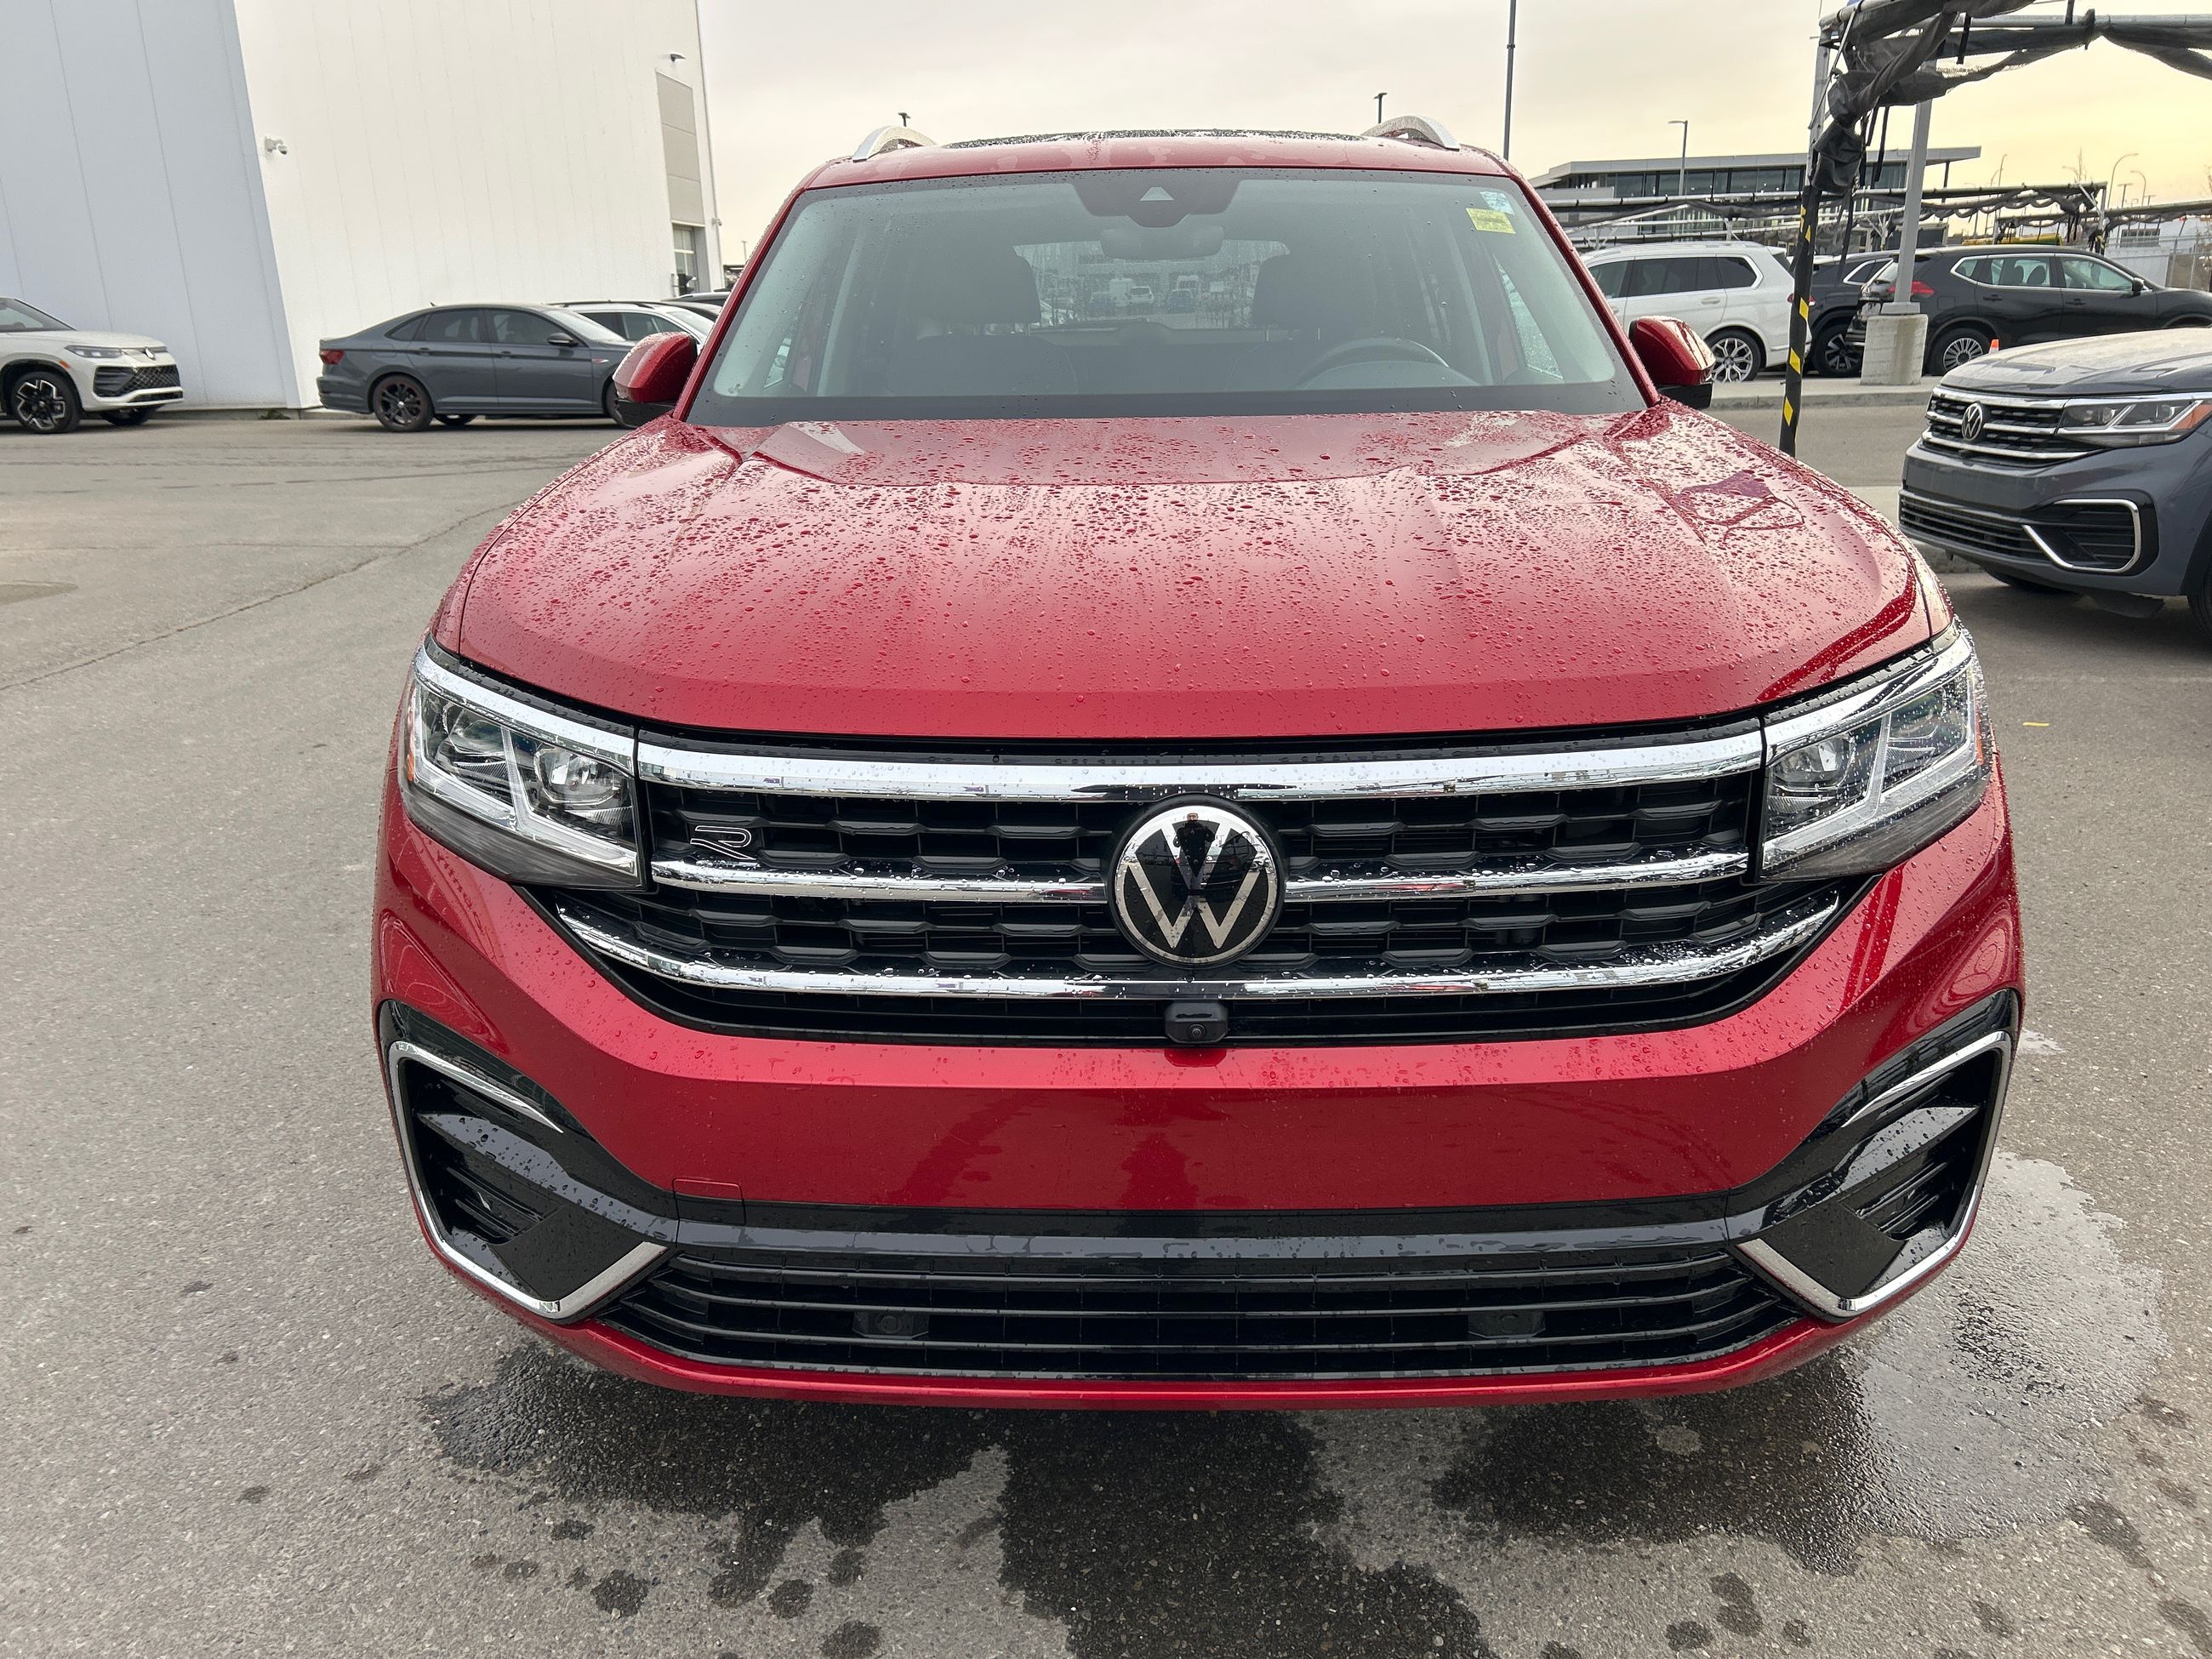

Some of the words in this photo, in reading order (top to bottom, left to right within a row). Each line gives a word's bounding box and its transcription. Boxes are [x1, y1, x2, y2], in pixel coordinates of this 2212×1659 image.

[1962, 403, 1982, 440] VW
[690, 825, 756, 860] R
[1118, 809, 1274, 959] VW
